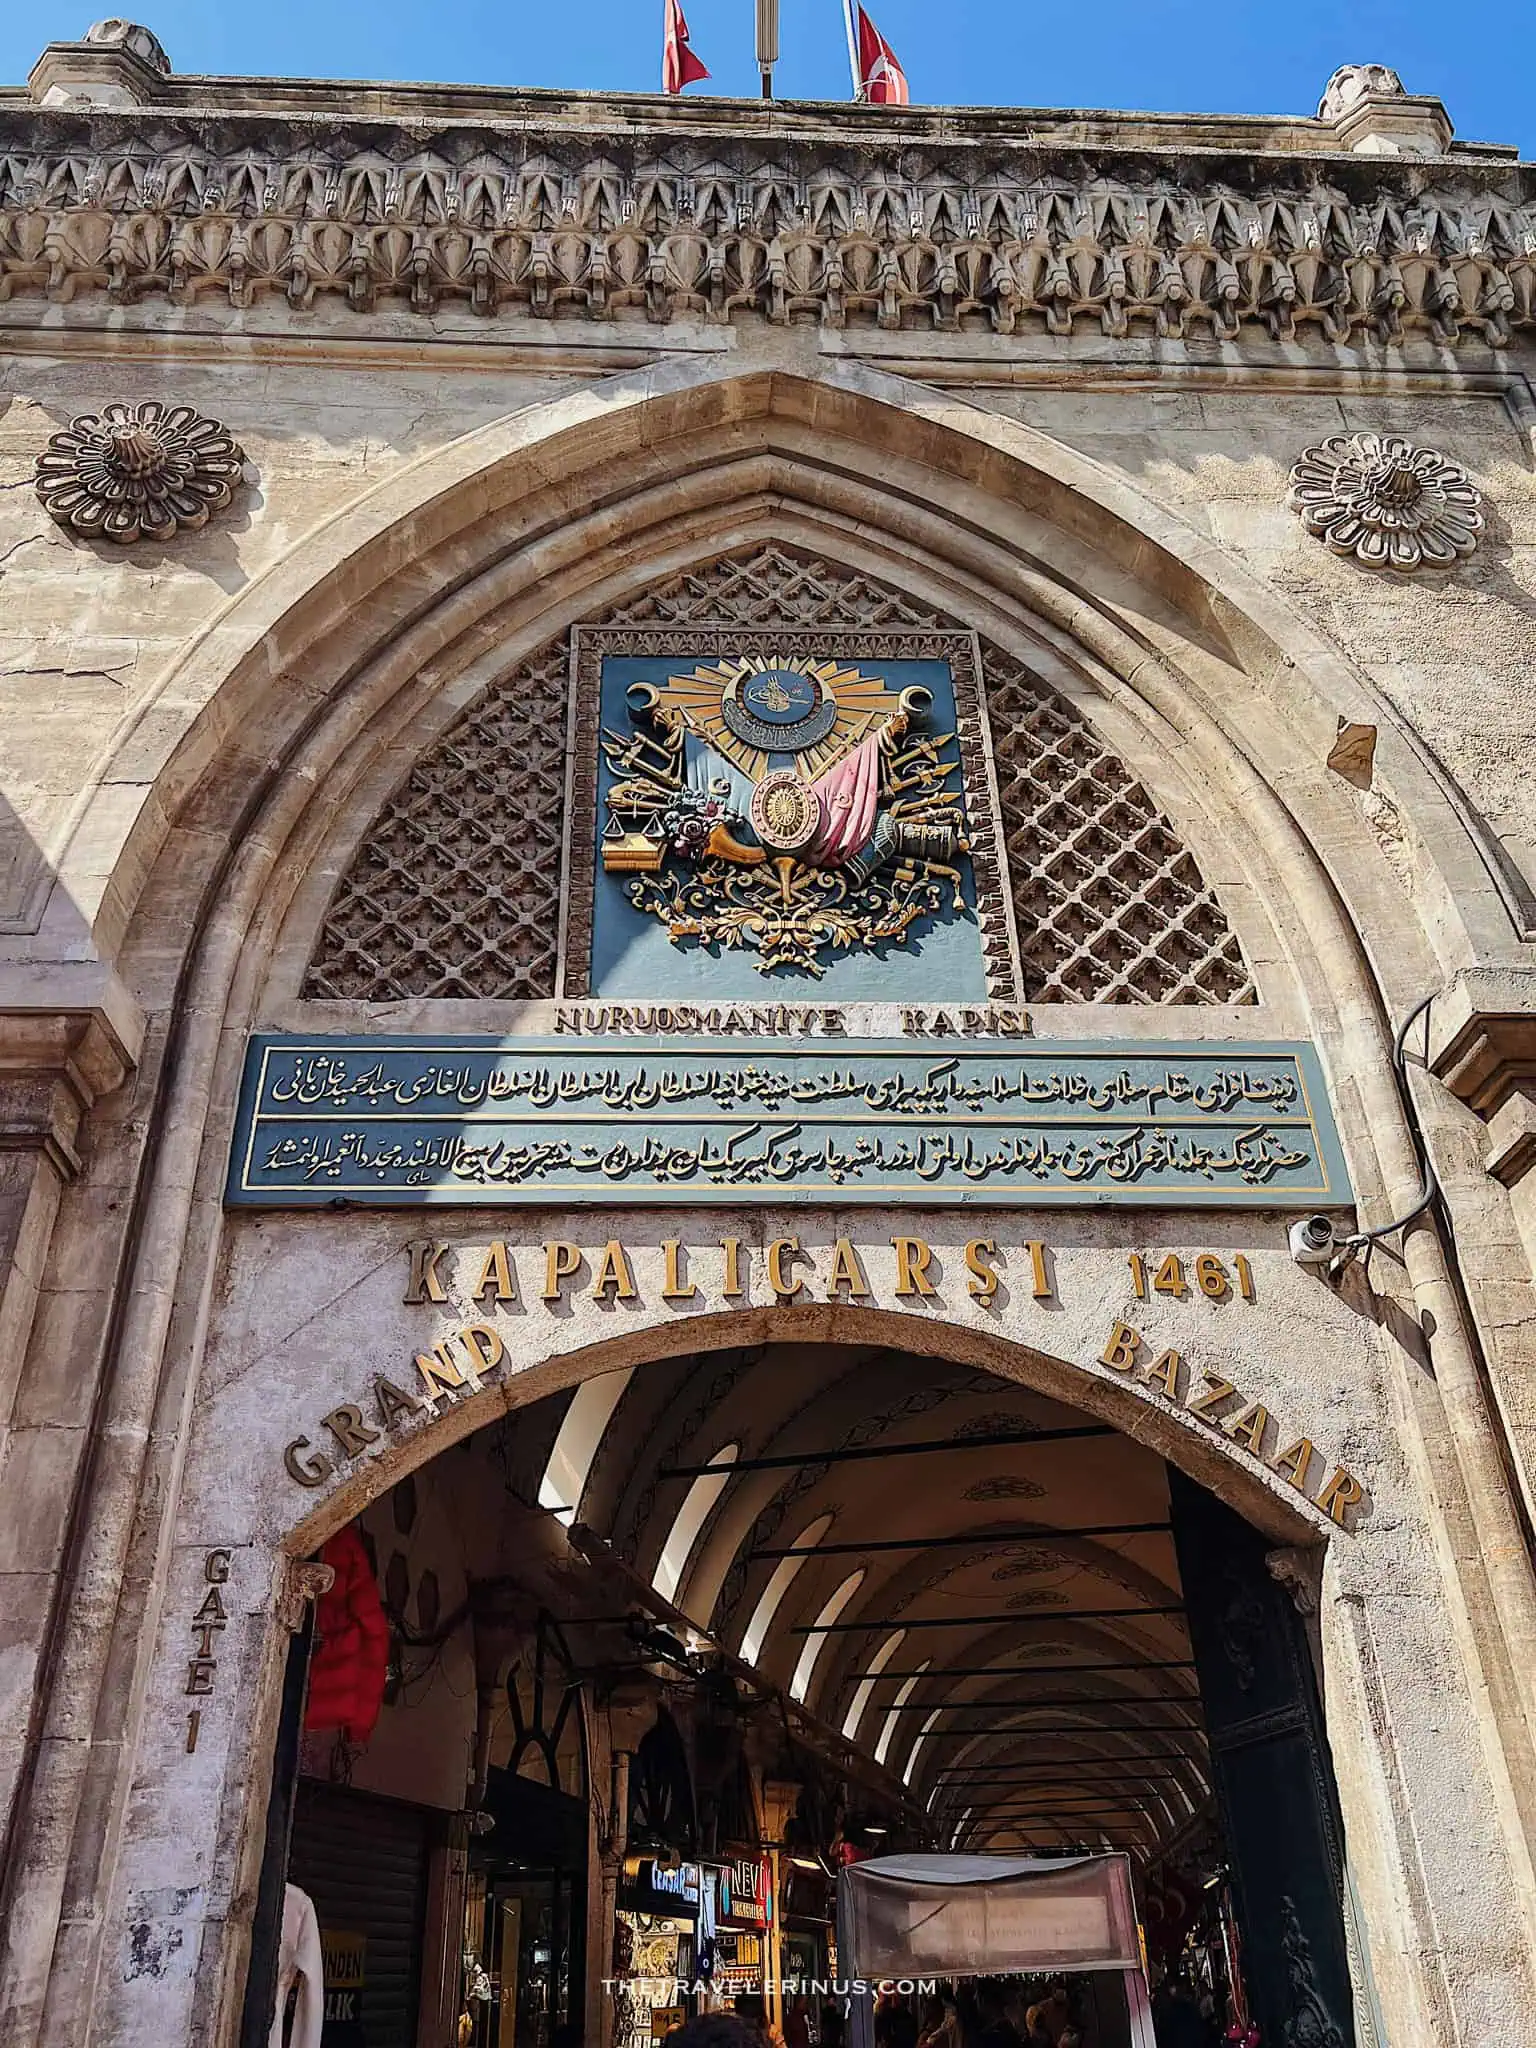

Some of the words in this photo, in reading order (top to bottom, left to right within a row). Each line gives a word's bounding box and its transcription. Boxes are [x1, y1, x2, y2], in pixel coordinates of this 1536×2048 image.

[900, 1008, 1032, 1034] KAPISI
[1128, 1254, 1252, 1298] 1461
[284, 1324, 505, 1487] GRAND
[1098, 1320, 1363, 1524] BAZAAR
[184, 1549, 232, 1696] GATE
[185, 1709, 200, 1754] 1
